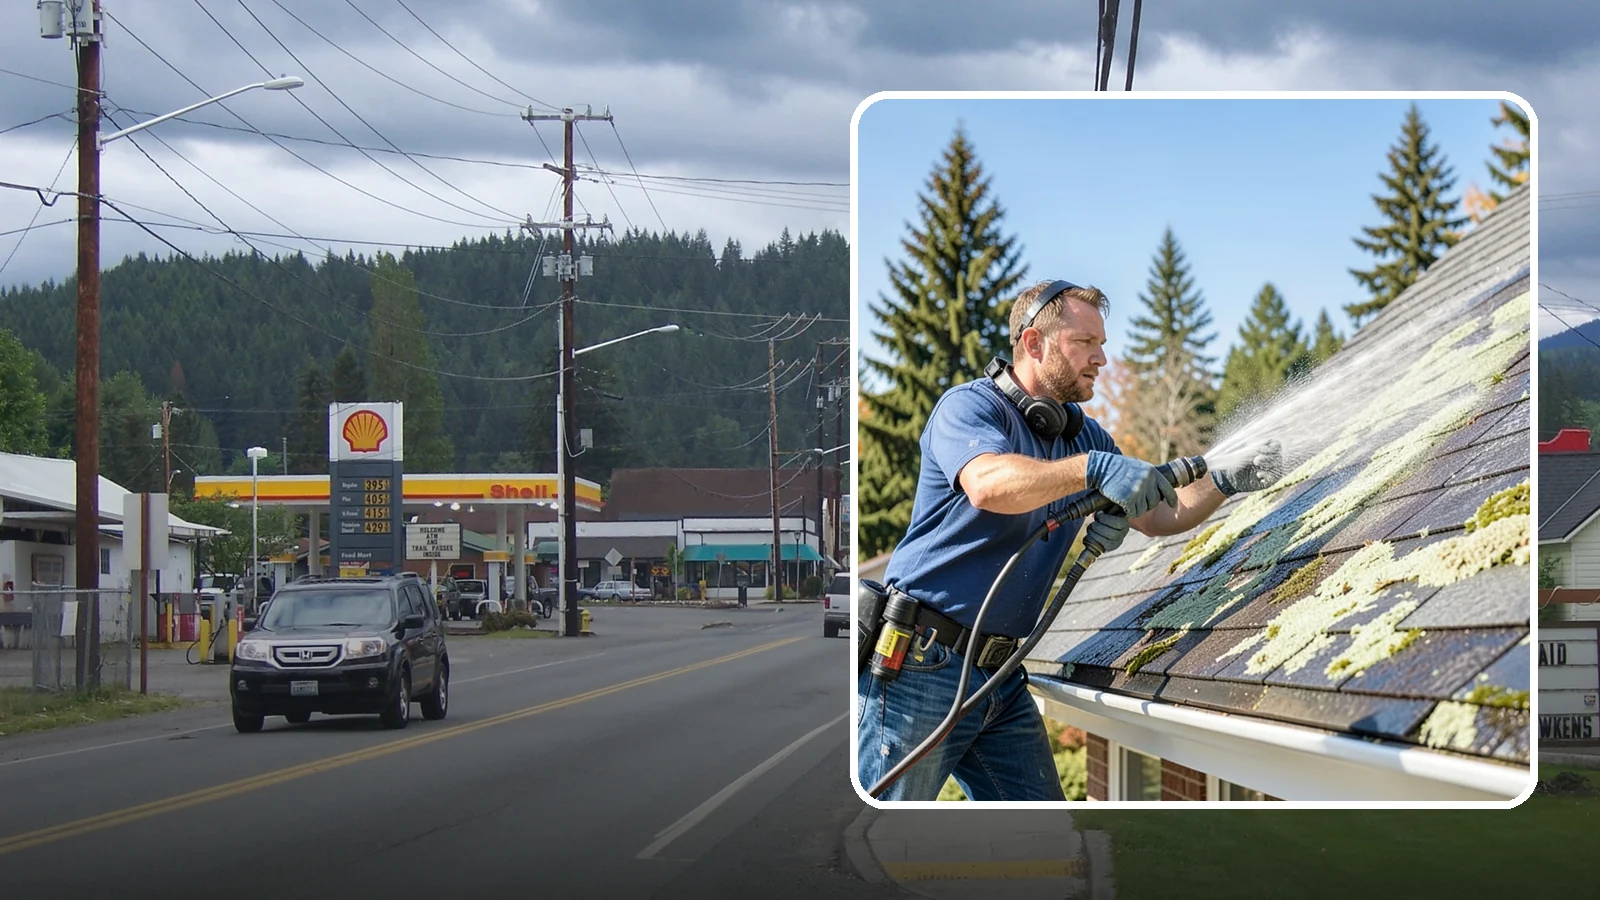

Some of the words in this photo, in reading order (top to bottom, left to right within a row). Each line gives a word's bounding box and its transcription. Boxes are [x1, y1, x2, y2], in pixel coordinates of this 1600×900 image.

[366, 480, 383, 490] 395
[489, 484, 547, 499] Shell
[366, 494, 383, 504] 405
[366, 508, 383, 518] 415
[366, 522, 383, 533] 429
